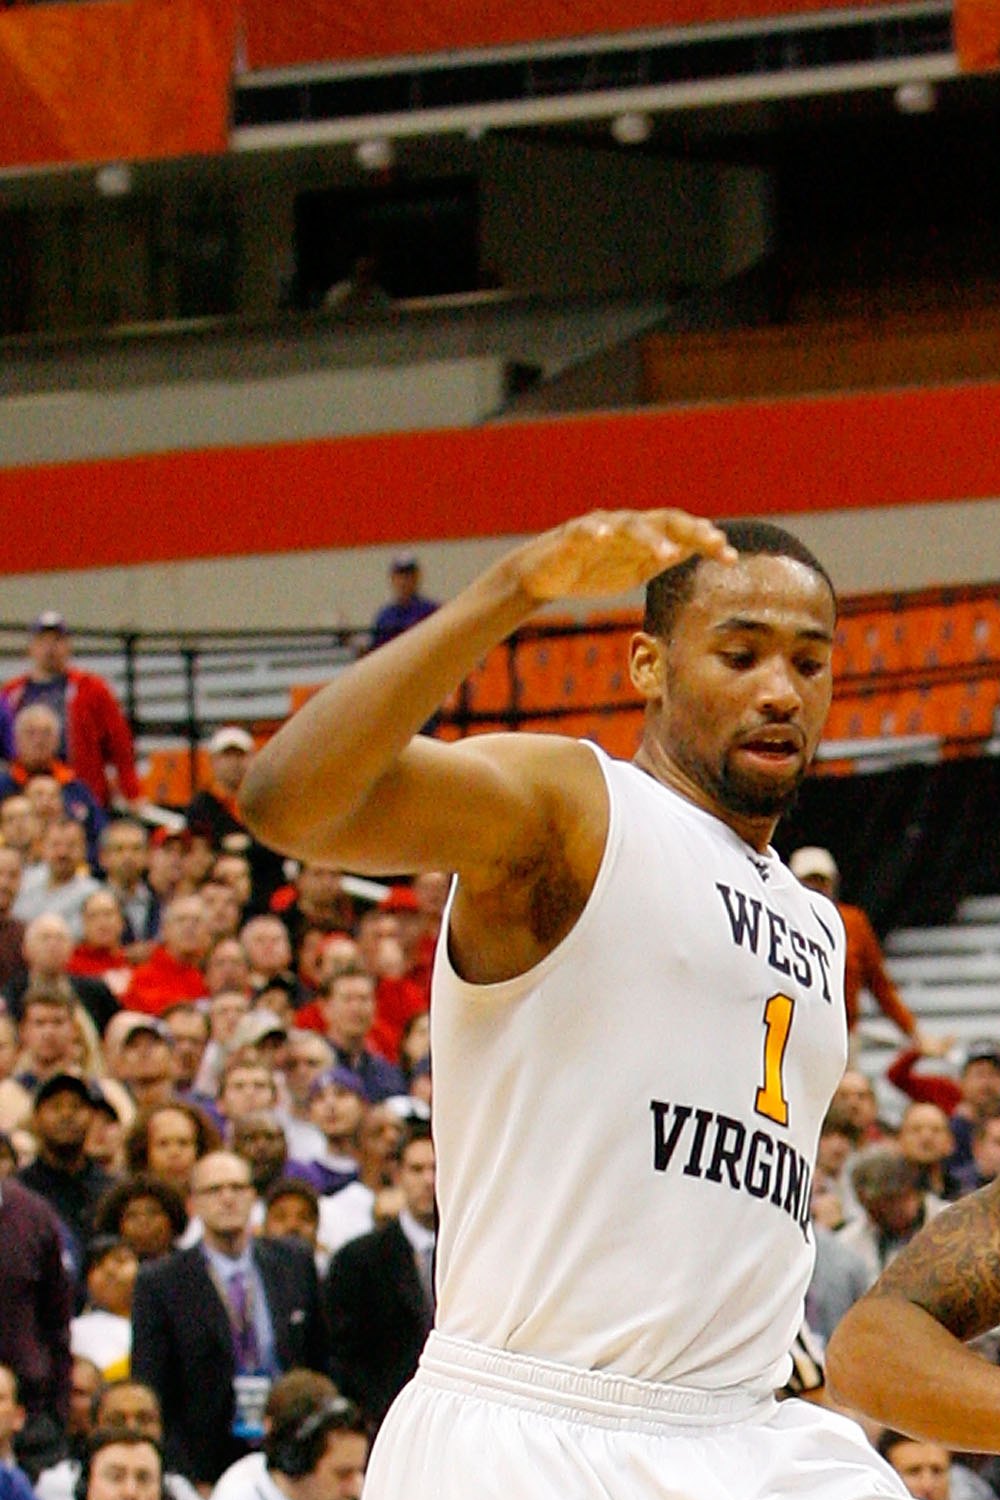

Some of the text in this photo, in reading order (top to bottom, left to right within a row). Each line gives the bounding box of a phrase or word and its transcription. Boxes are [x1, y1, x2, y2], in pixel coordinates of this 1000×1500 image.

[715, 881, 833, 1004] WEST
[754, 991, 796, 1128] 1
[650, 1099, 813, 1244] VIRGINI
